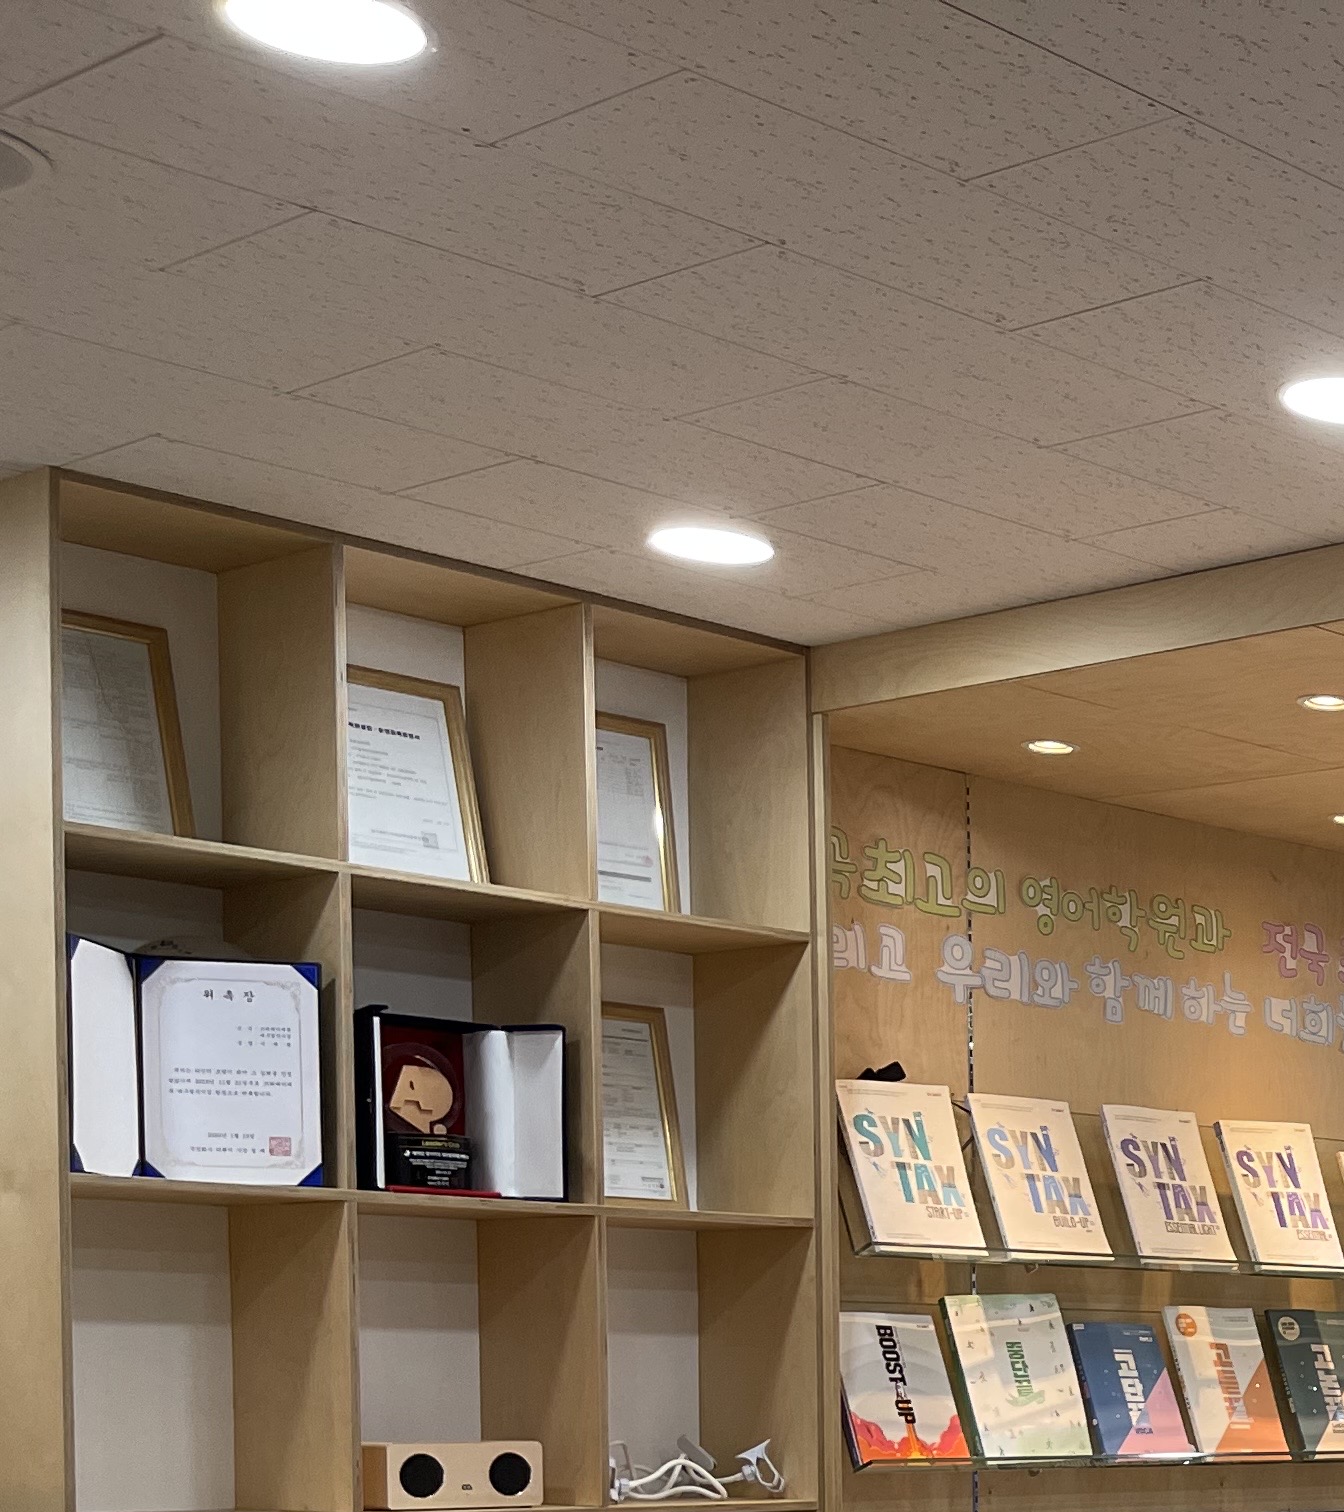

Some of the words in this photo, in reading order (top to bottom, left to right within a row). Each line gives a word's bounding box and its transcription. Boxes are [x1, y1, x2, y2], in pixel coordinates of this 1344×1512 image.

[1021, 875, 1231, 959] 영어학원과
[936, 934, 1079, 1008] 우리와
[875, 1324, 908, 1387] BOOST
[895, 1399, 916, 1425] UP
